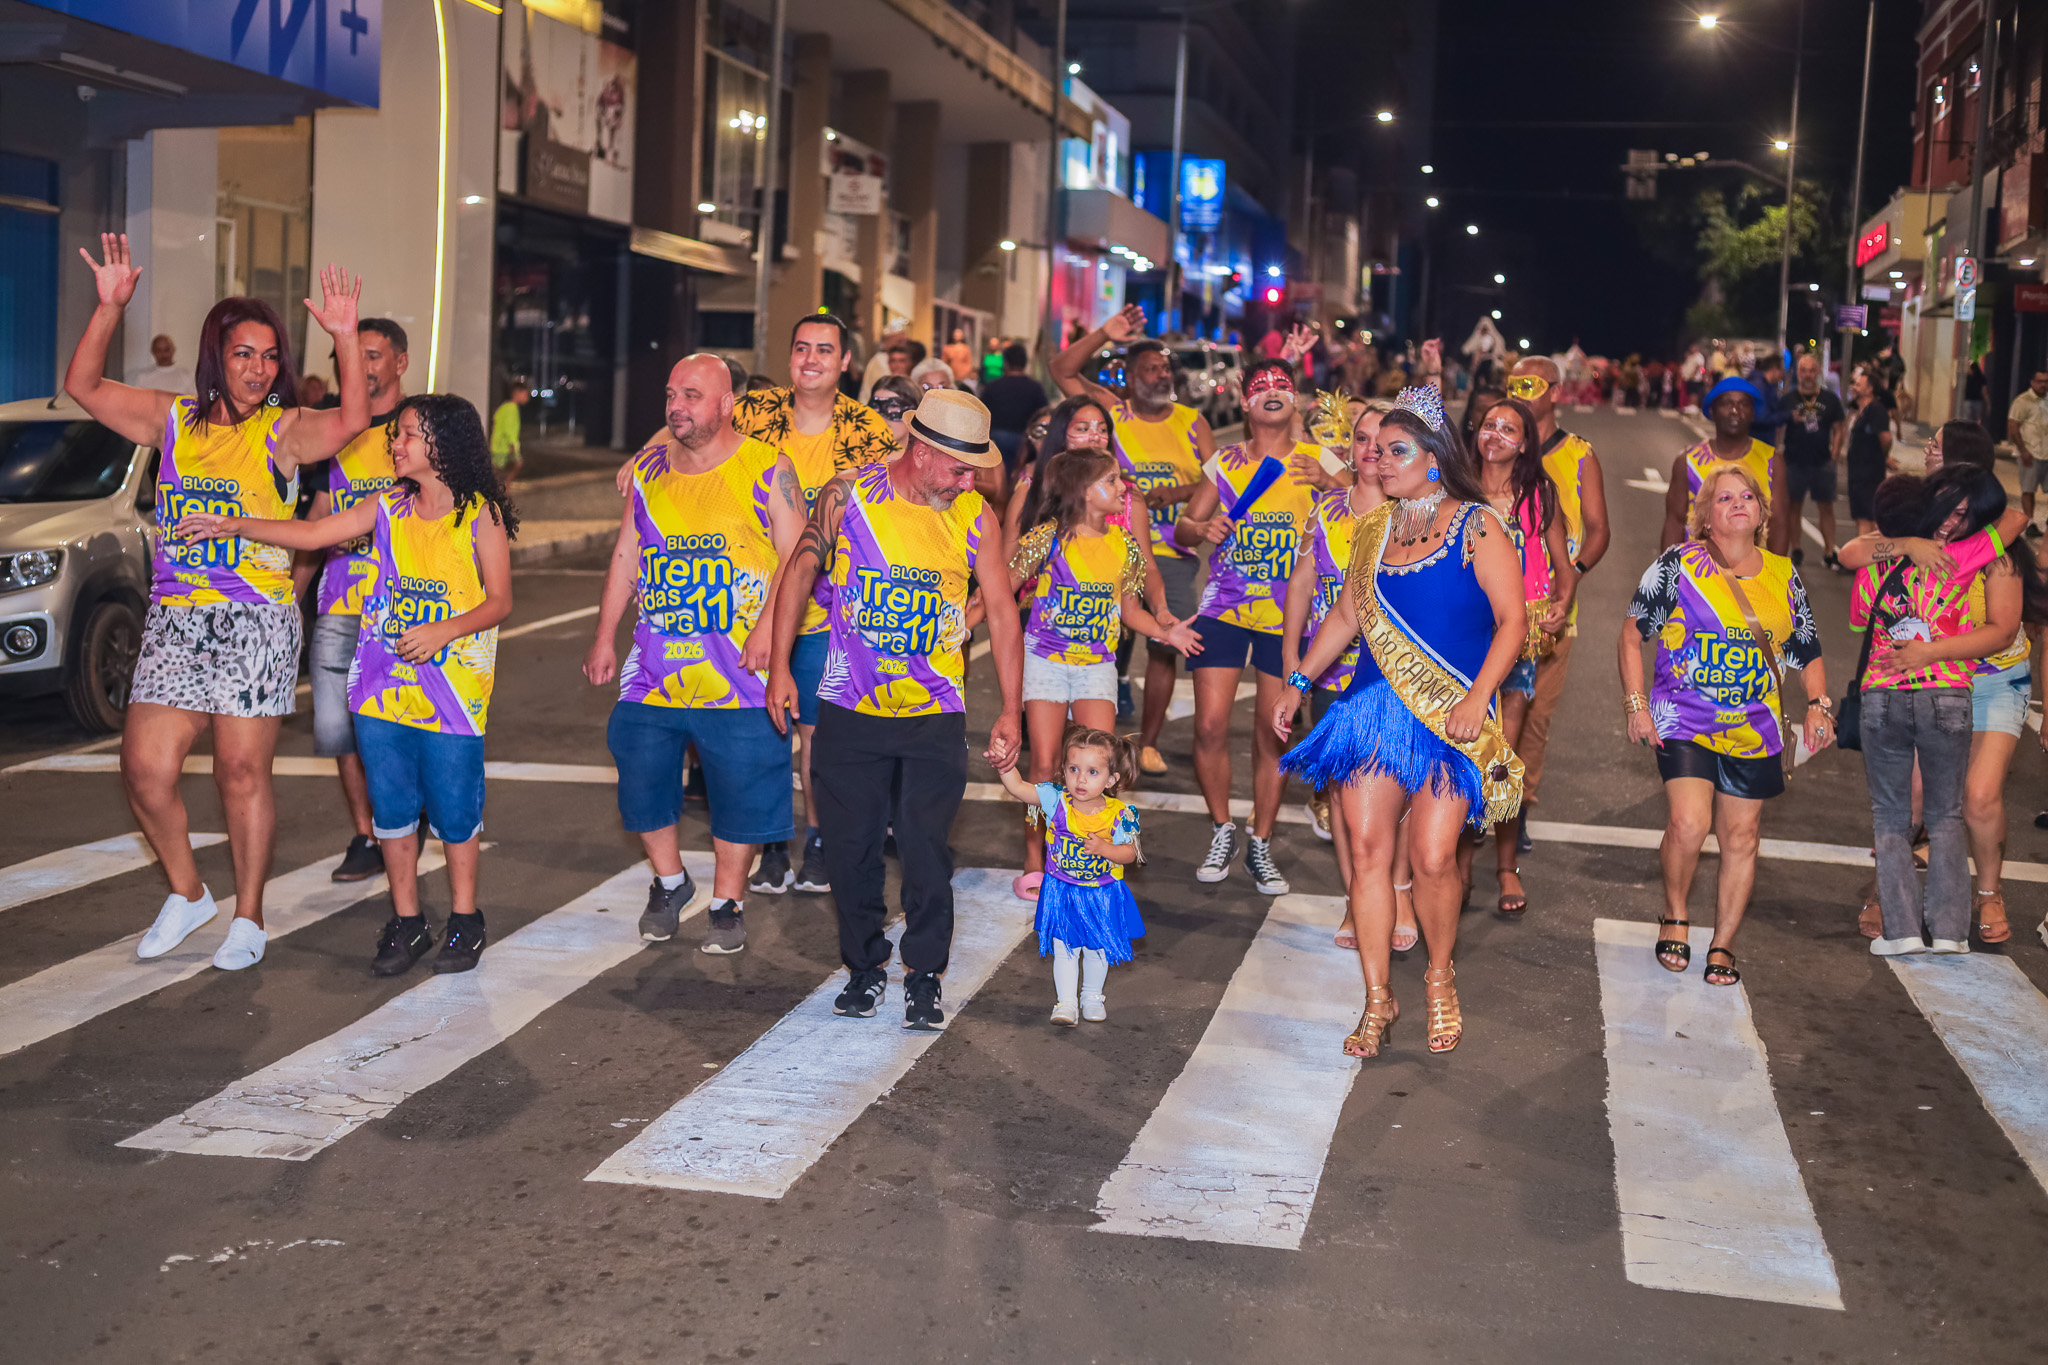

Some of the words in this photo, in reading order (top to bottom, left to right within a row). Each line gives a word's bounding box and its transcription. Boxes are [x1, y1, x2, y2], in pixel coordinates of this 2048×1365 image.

[1963, 265, 1972, 281] E
[1134, 463, 1175, 473] BLOCO
[182, 477, 239, 494] BLOCO
[351, 477, 394, 491] BLOCO
[1252, 512, 1294, 523] BLOCO
[348, 538, 370, 555] PG
[666, 534, 725, 550] BLOCO
[175, 545, 203, 567] PG
[1233, 548, 1263, 562] das
[1265, 548, 1292, 579] 11
[642, 546, 732, 587] Trem
[890, 565, 941, 584] BLOCO
[1248, 564, 1269, 580] PG
[400, 577, 447, 594] BLOCO
[857, 569, 942, 616] Trem
[1080, 582, 1115, 593] BLOCO
[1245, 583, 1272, 597] 2026
[643, 588, 682, 611] das
[685, 585, 728, 630] 11
[1056, 585, 1114, 615] Trem
[663, 612, 694, 633] PG
[858, 607, 900, 628] das
[902, 614, 936, 653] 11
[1055, 612, 1087, 625] das
[1087, 614, 1108, 640] 11
[878, 632, 906, 654] PG
[1070, 628, 1090, 641] PG
[1374, 631, 1398, 656] DO
[663, 641, 704, 660] 2026
[390, 662, 418, 682] 2026
[876, 658, 909, 675] 2026
[1694, 666, 1737, 684] das
[1739, 669, 1770, 700] 11
[1717, 687, 1742, 706] PG
[1714, 710, 1747, 724] 2026
[1061, 858, 1086, 869] das
[1087, 859, 1108, 876] 11
[1076, 870, 1094, 881] PG
